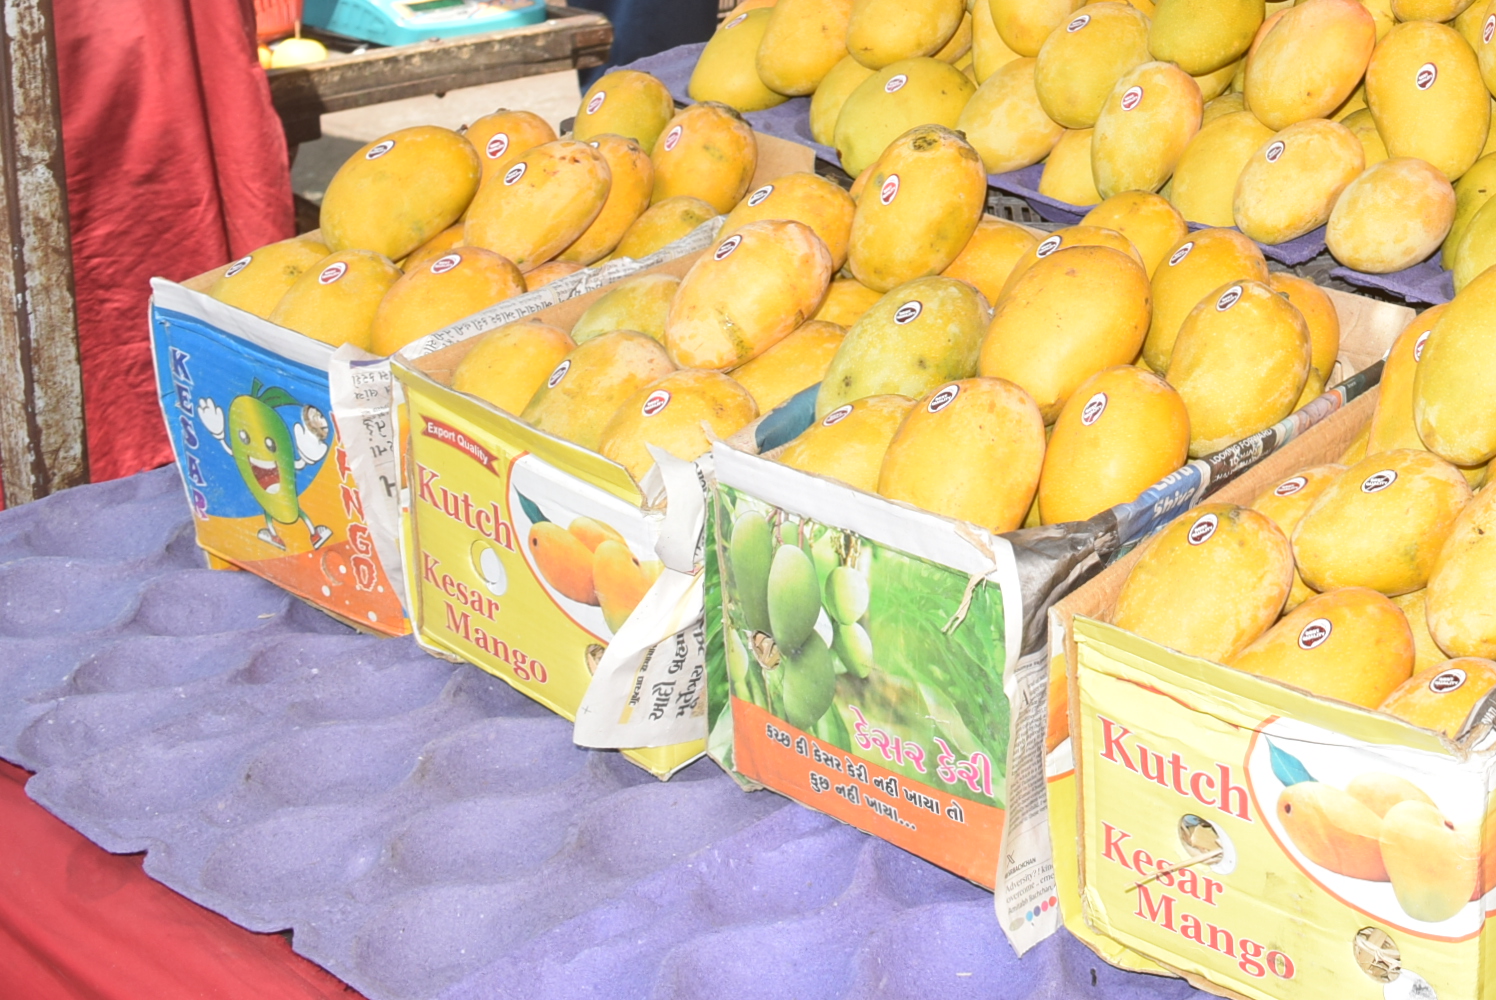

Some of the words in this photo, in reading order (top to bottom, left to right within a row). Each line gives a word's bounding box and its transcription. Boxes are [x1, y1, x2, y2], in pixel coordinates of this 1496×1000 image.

[169, 347, 209, 521] KESAR
[427, 422, 456, 446] Export
[456, 434, 489, 465] Quality
[415, 463, 515, 551] Kutch
[422, 550, 501, 623] Kesar
[444, 599, 549, 684] Mango
[765, 724, 791, 748] કચ્છ
[812, 741, 843, 772] કેસર
[845, 756, 868, 784] કેરી
[903, 787, 940, 815] ખાયા
[946, 801, 964, 823] તો
[810, 772, 831, 793] કુછ
[850, 704, 927, 773] કેસર
[934, 737, 994, 797] કેરી
[1097, 714, 1254, 822] Kutch
[1101, 821, 1224, 907] Kesar
[1133, 881, 1296, 981] Mango
